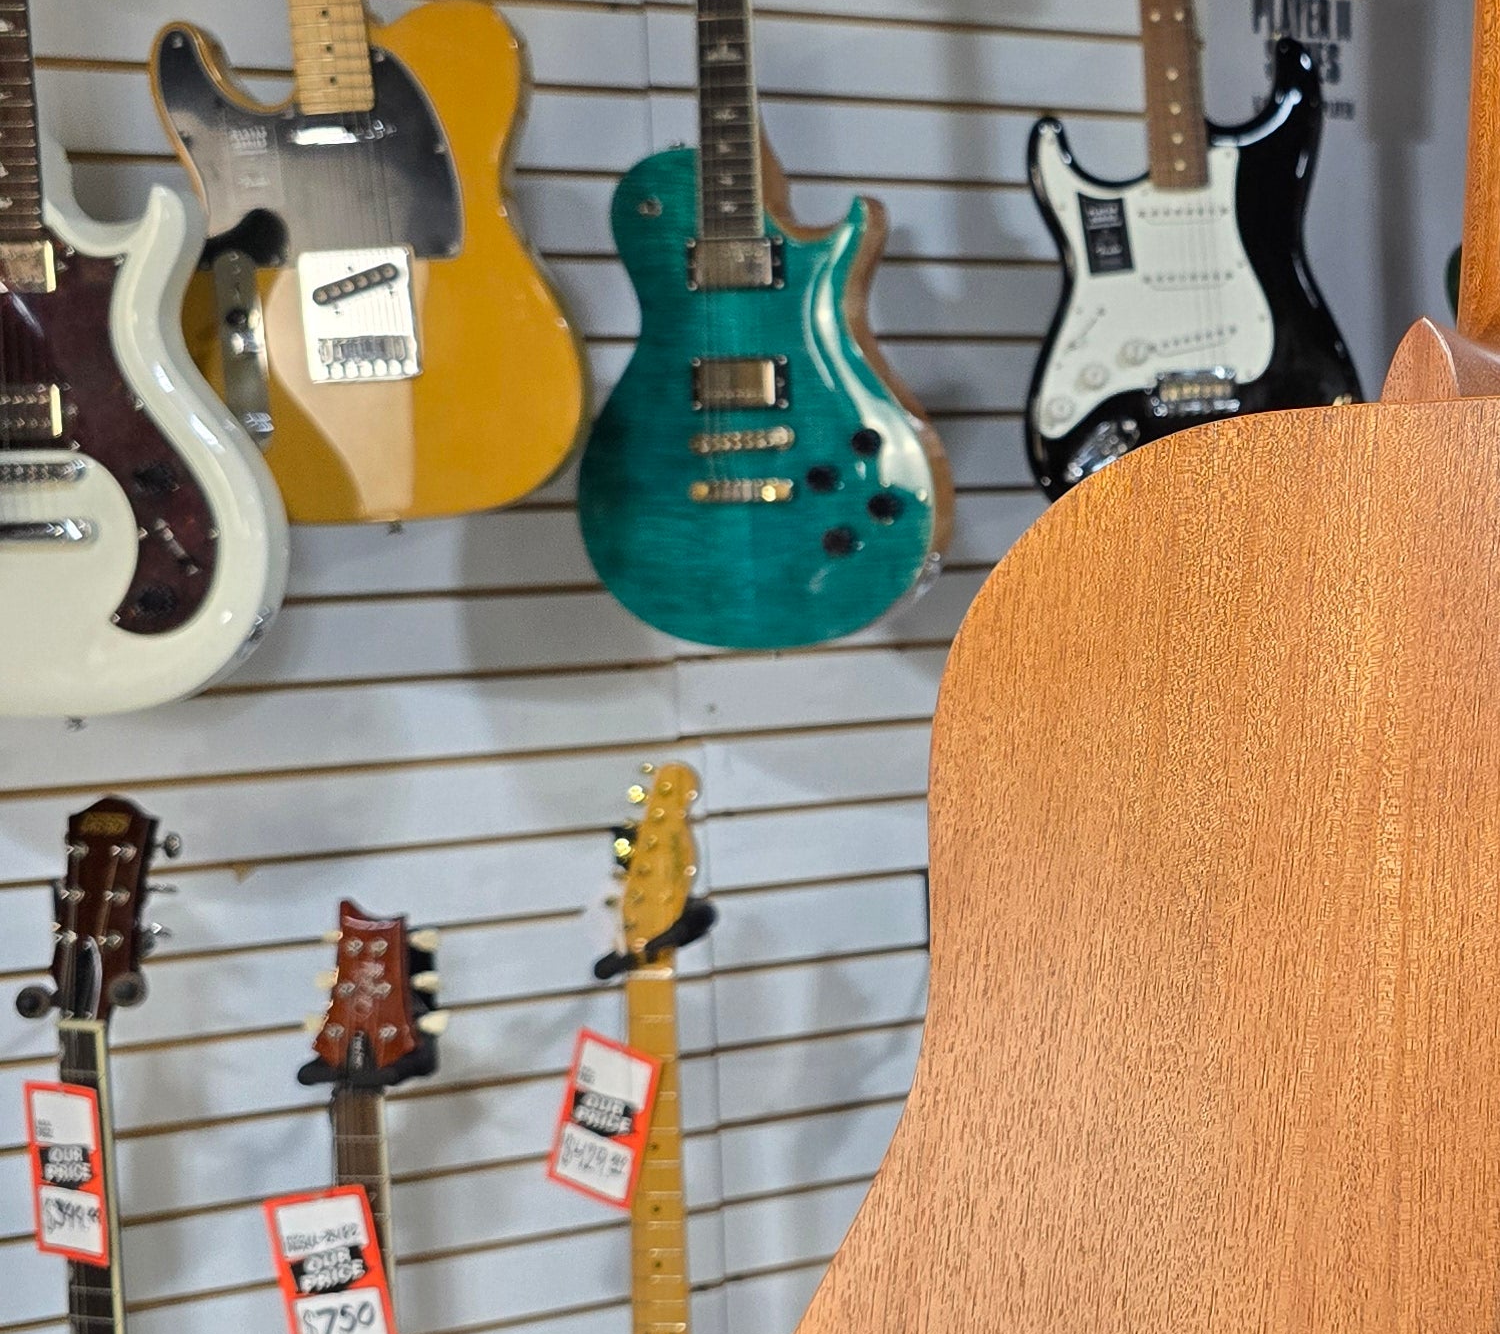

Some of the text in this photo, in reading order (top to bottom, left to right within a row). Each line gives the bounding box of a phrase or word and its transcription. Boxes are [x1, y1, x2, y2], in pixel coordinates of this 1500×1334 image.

[580, 1091, 626, 1117] OUR
[573, 1105, 633, 1135] PRICE
[47, 1146, 84, 1163] OUR
[44, 1162, 93, 1183] PRICE
[302, 1246, 352, 1274] OUR
[300, 1258, 367, 1294] PRICE
